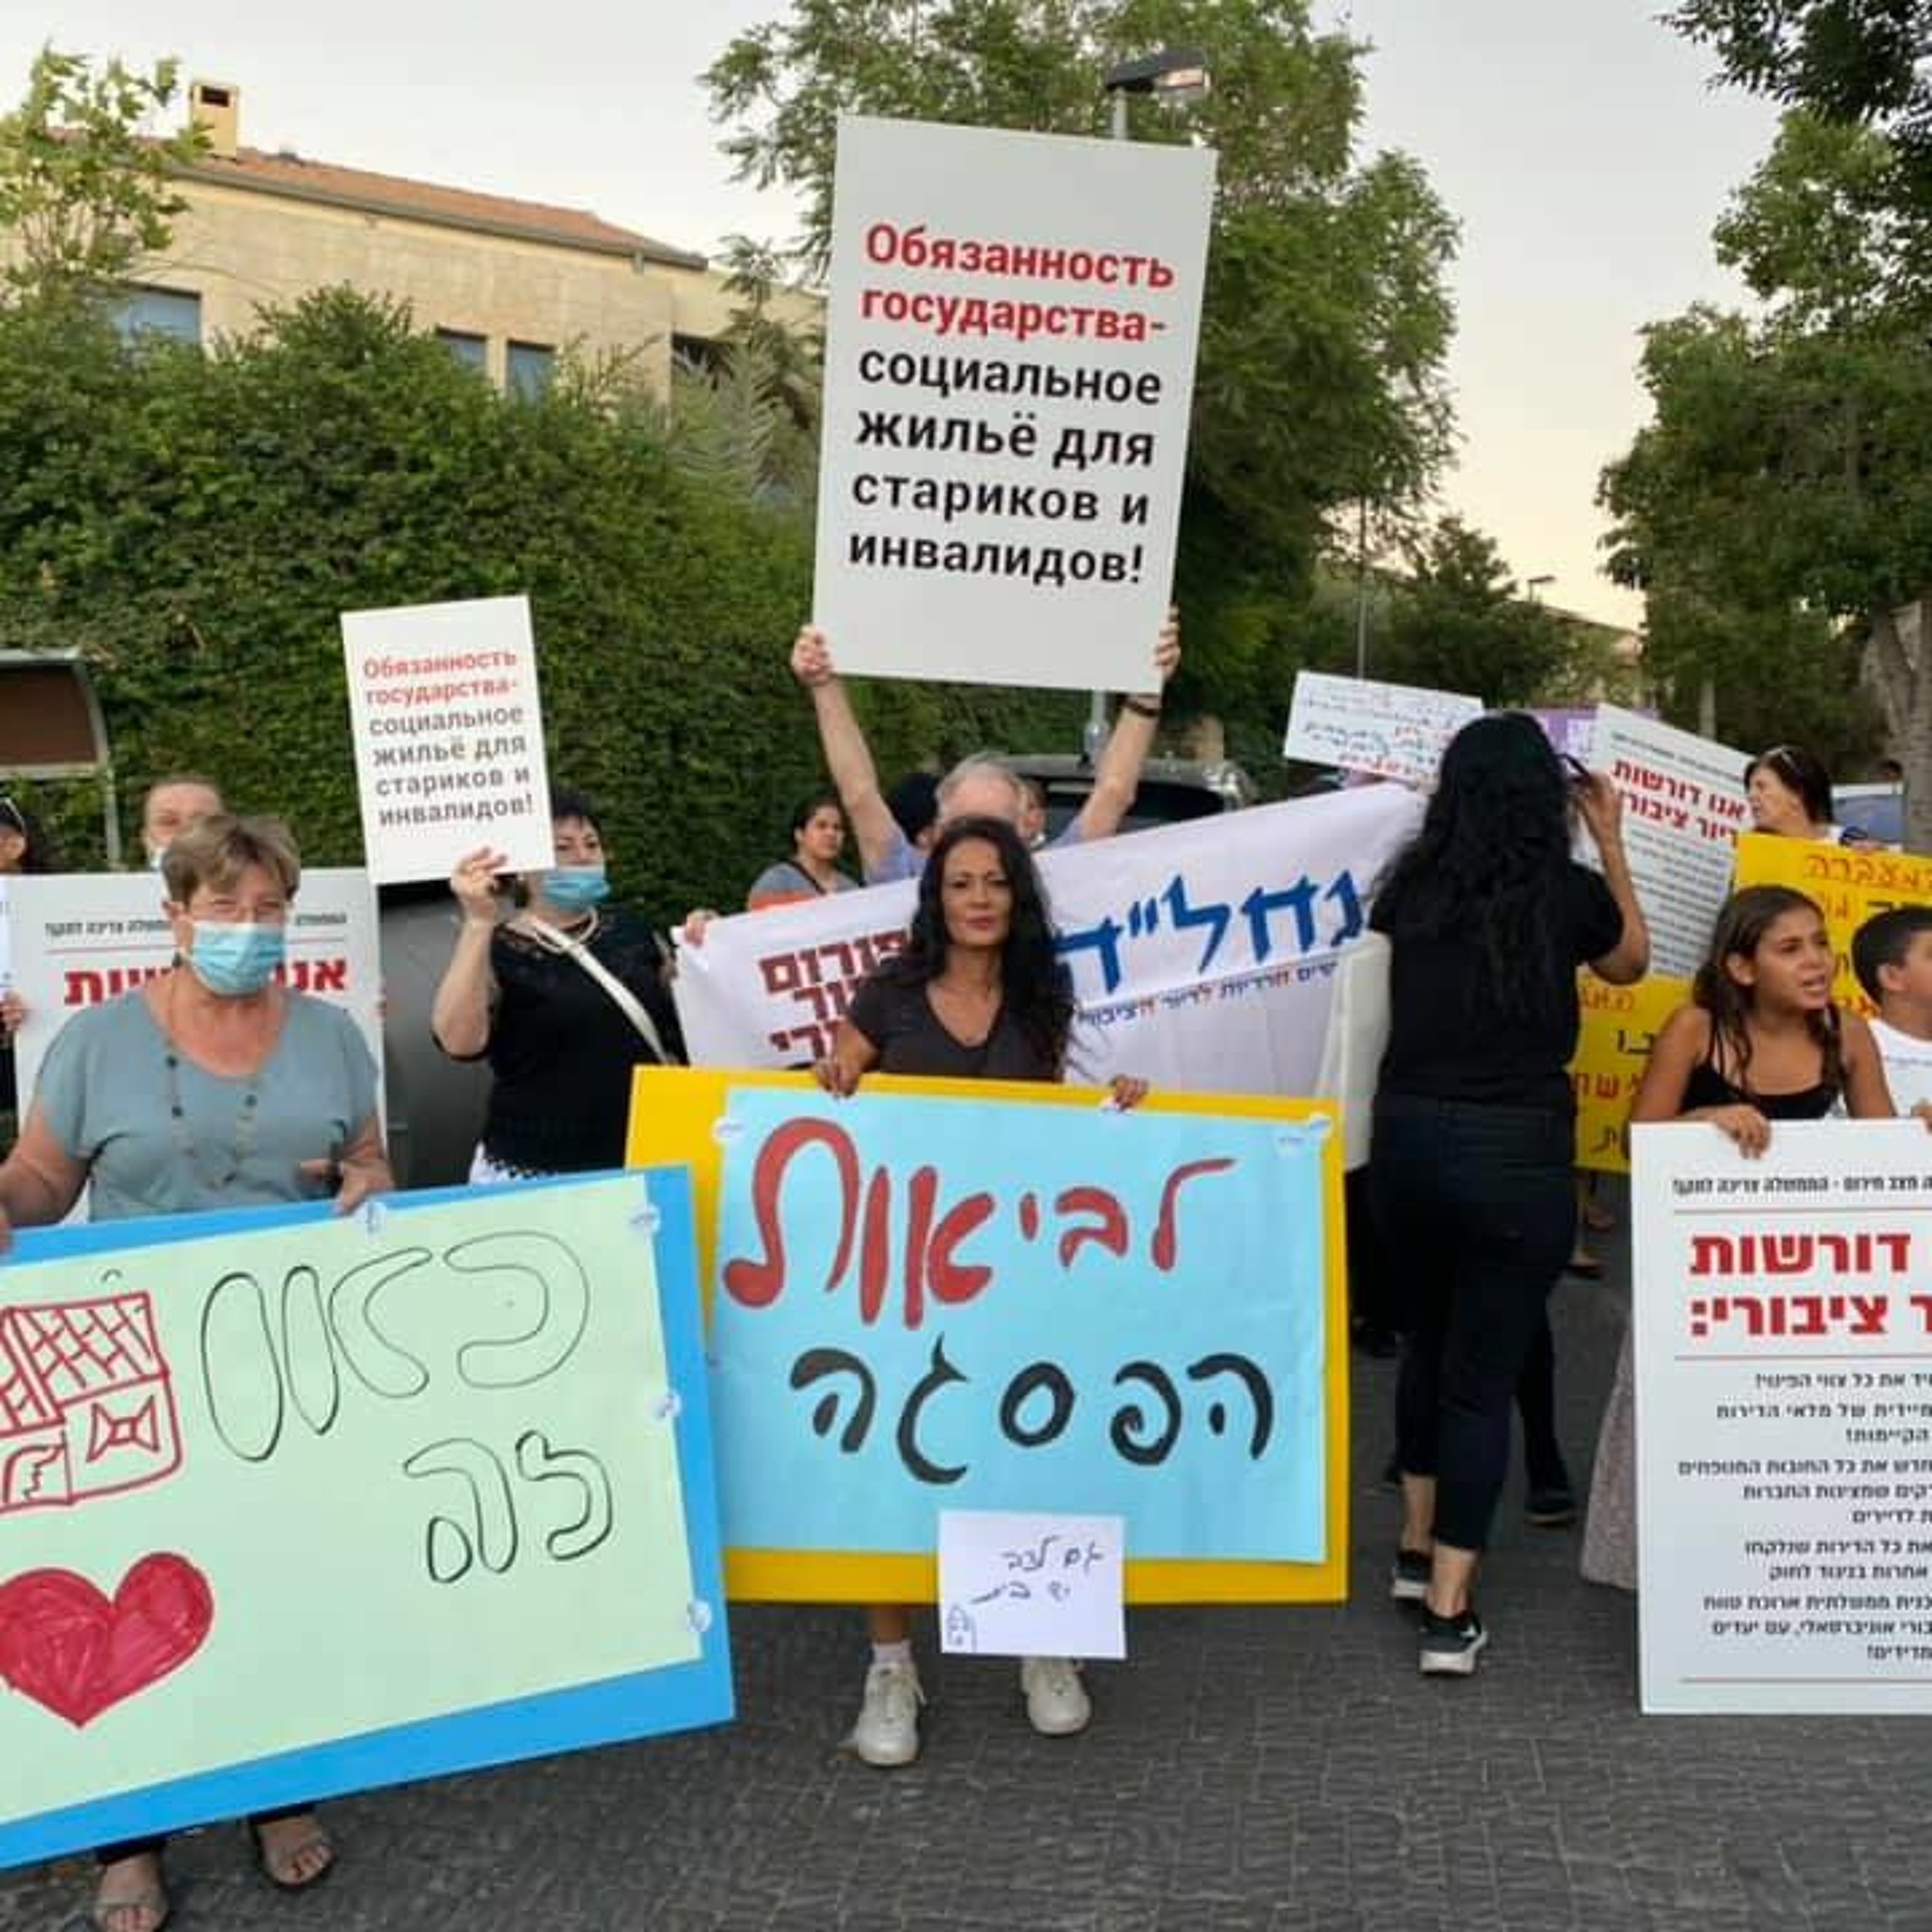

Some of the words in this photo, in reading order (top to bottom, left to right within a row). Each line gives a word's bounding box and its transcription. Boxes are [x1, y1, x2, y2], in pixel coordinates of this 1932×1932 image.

[866, 223, 1174, 290] Обязанность
[861, 289, 1166, 343] государства-
[859, 349, 1161, 406] социальное
[857, 410, 1037, 456] жильё
[1053, 428, 1155, 469] для
[853, 473, 1099, 522] стариков
[1121, 492, 1149, 526] и
[849, 533, 1142, 587] инвалидов!
[363, 651, 517, 678] Обязанность
[366, 678, 518, 707] государства-
[369, 706, 524, 735] социальное
[374, 737, 466, 766] жильё
[475, 735, 526, 757] для
[376, 769, 504, 798] стариков
[515, 768, 531, 782] и
[1613, 760, 1702, 806] דורשות
[379, 794, 533, 826] инвалидов!
[723, 1117, 1235, 1330] לביאות
[1690, 1233, 1911, 1274] דורשות
[1690, 1296, 1888, 1336] ציבורי:
[1852, 1374, 1875, 1388] כל
[1879, 1374, 1906, 1387] את
[791, 1334, 1274, 1485] הפסגה
[1716, 1404, 1779, 1418] הדירות
[1786, 1403, 1831, 1417] מלאי
[1838, 1403, 1866, 1417] של
[1834, 1459, 1856, 1474] כל
[1861, 1458, 1888, 1475] את
[1743, 1485, 1810, 1501] החברות
[1815, 1539, 1874, 1555] הדירות
[1879, 1539, 1902, 1555] כל
[1769, 1565, 1812, 1582] לחוק
[1871, 1564, 1927, 1579] אחרות
[1765, 1620, 1792, 1636] עם
